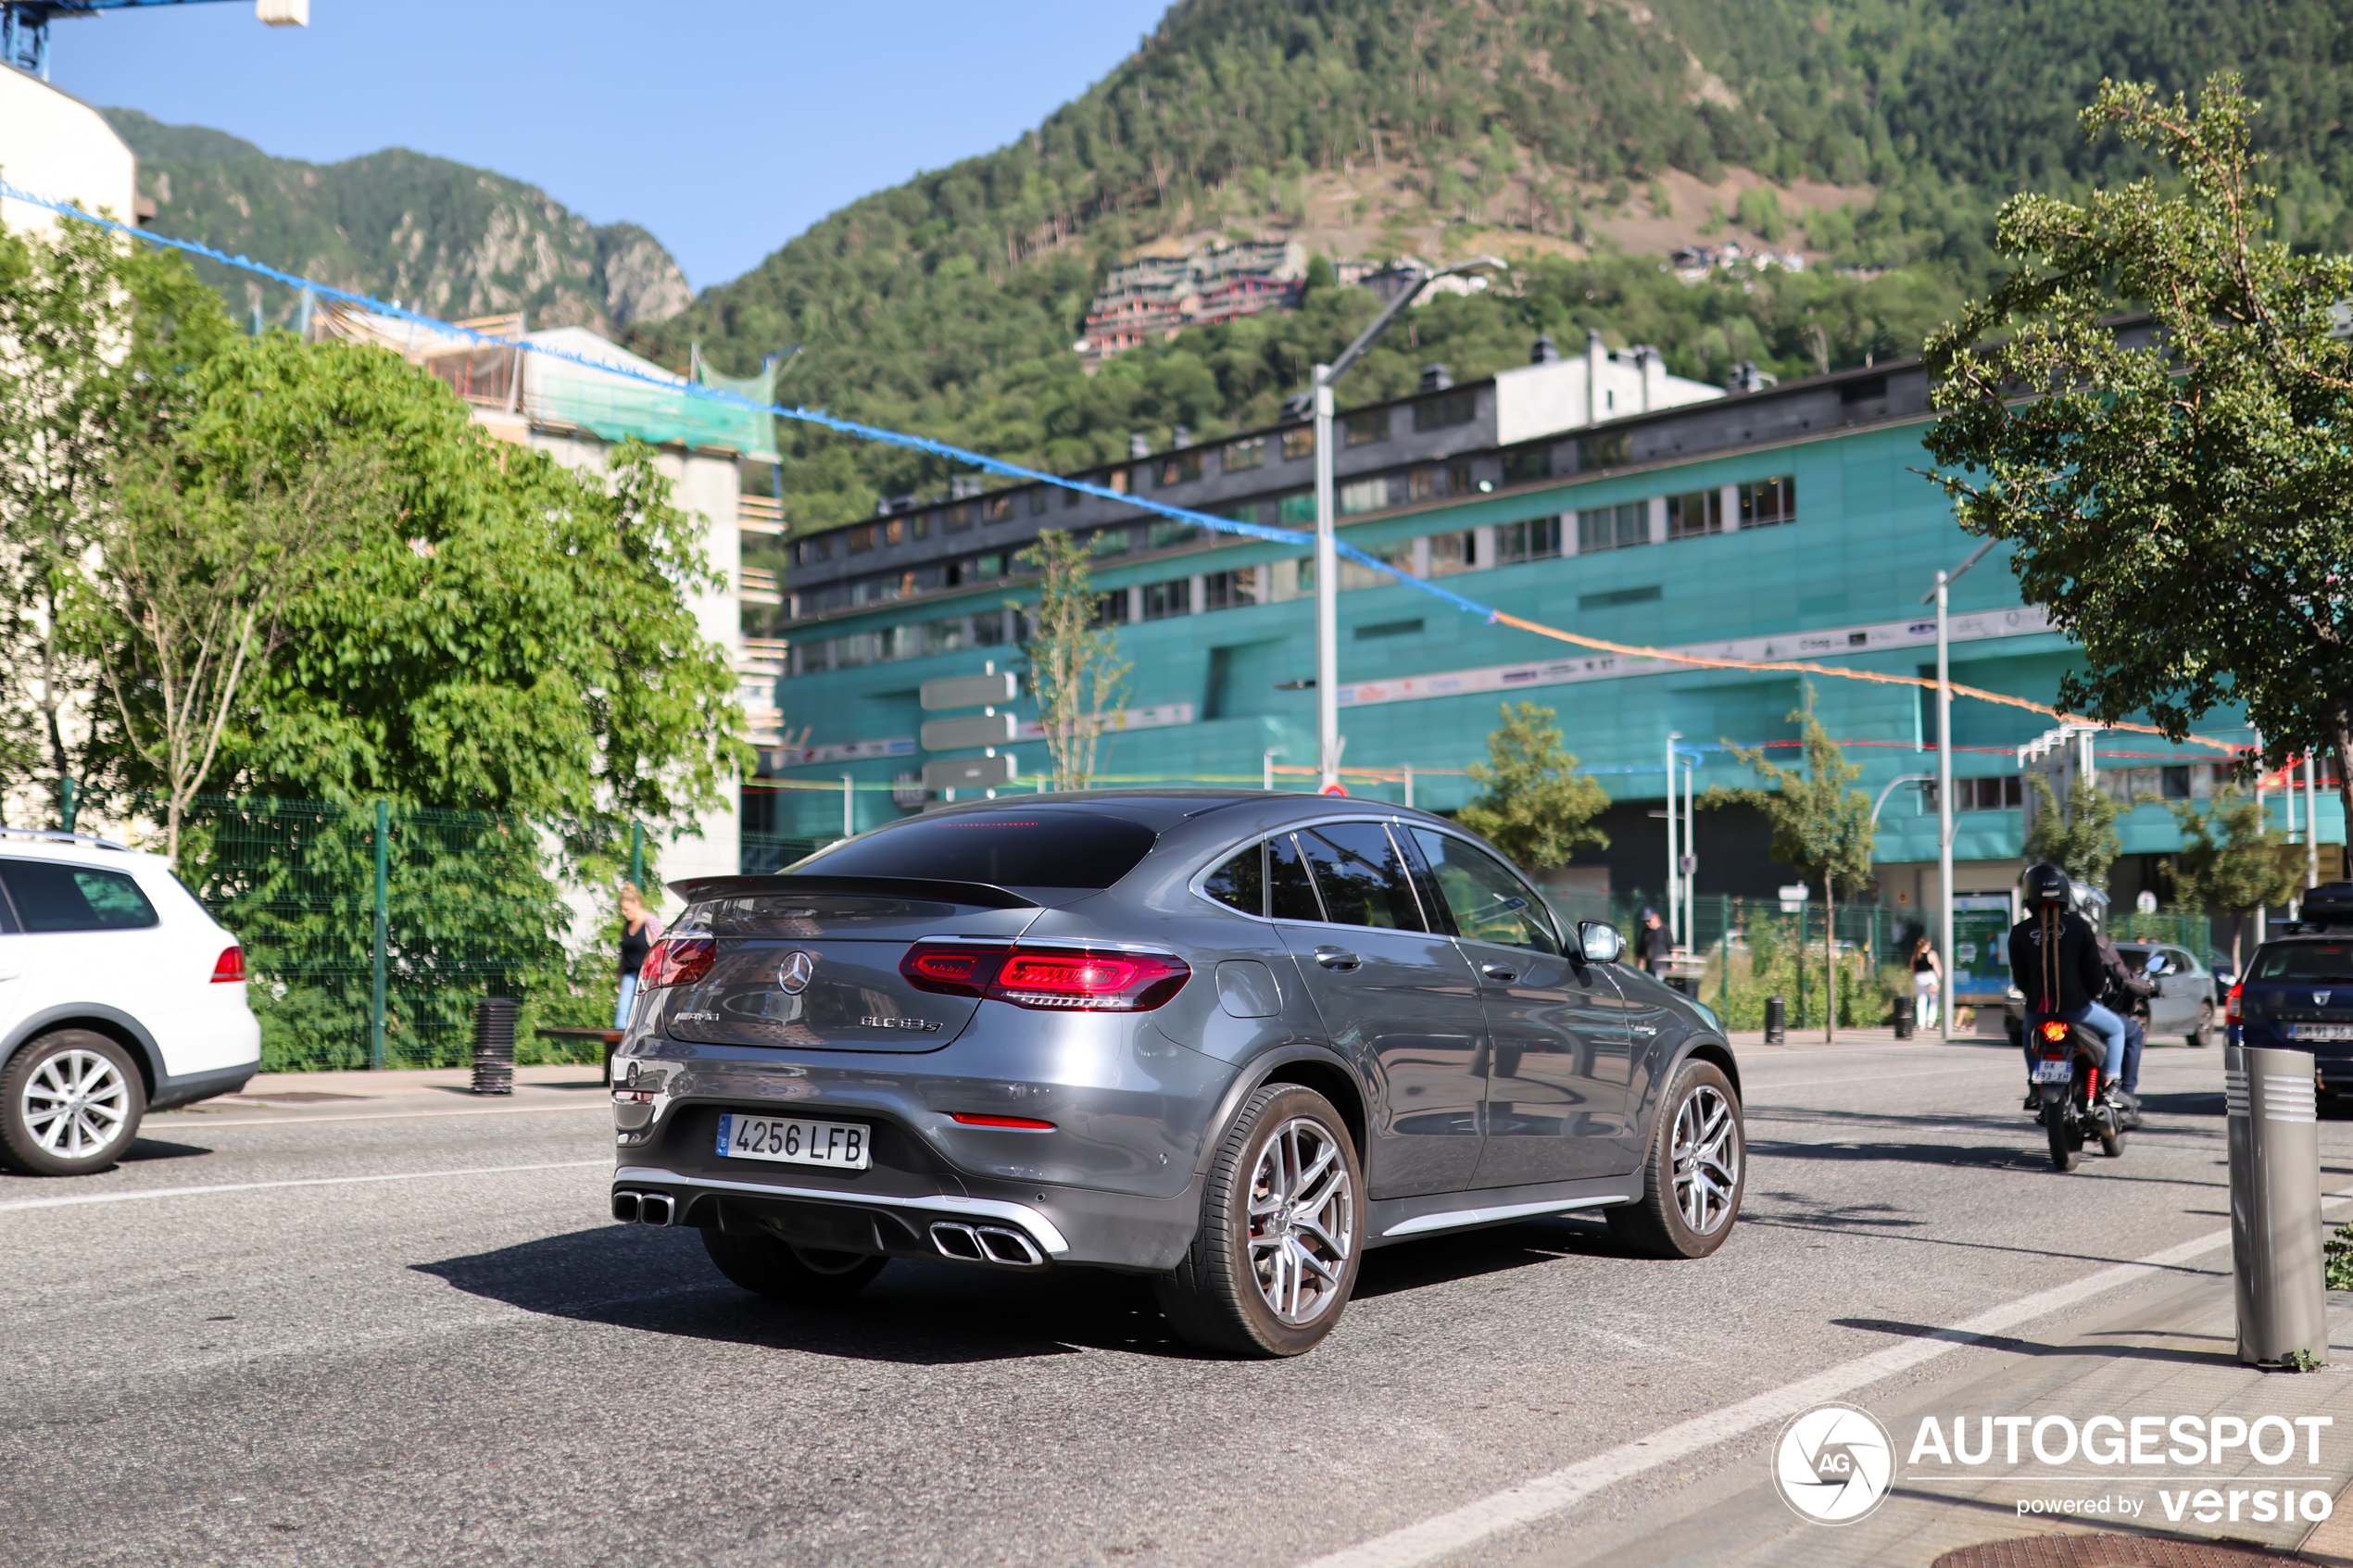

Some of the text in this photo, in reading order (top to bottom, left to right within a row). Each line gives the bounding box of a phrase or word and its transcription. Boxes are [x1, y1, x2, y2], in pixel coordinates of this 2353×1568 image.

[860, 1016, 895, 1028] GLC
[736, 1120, 862, 1162] 4256 LFB
